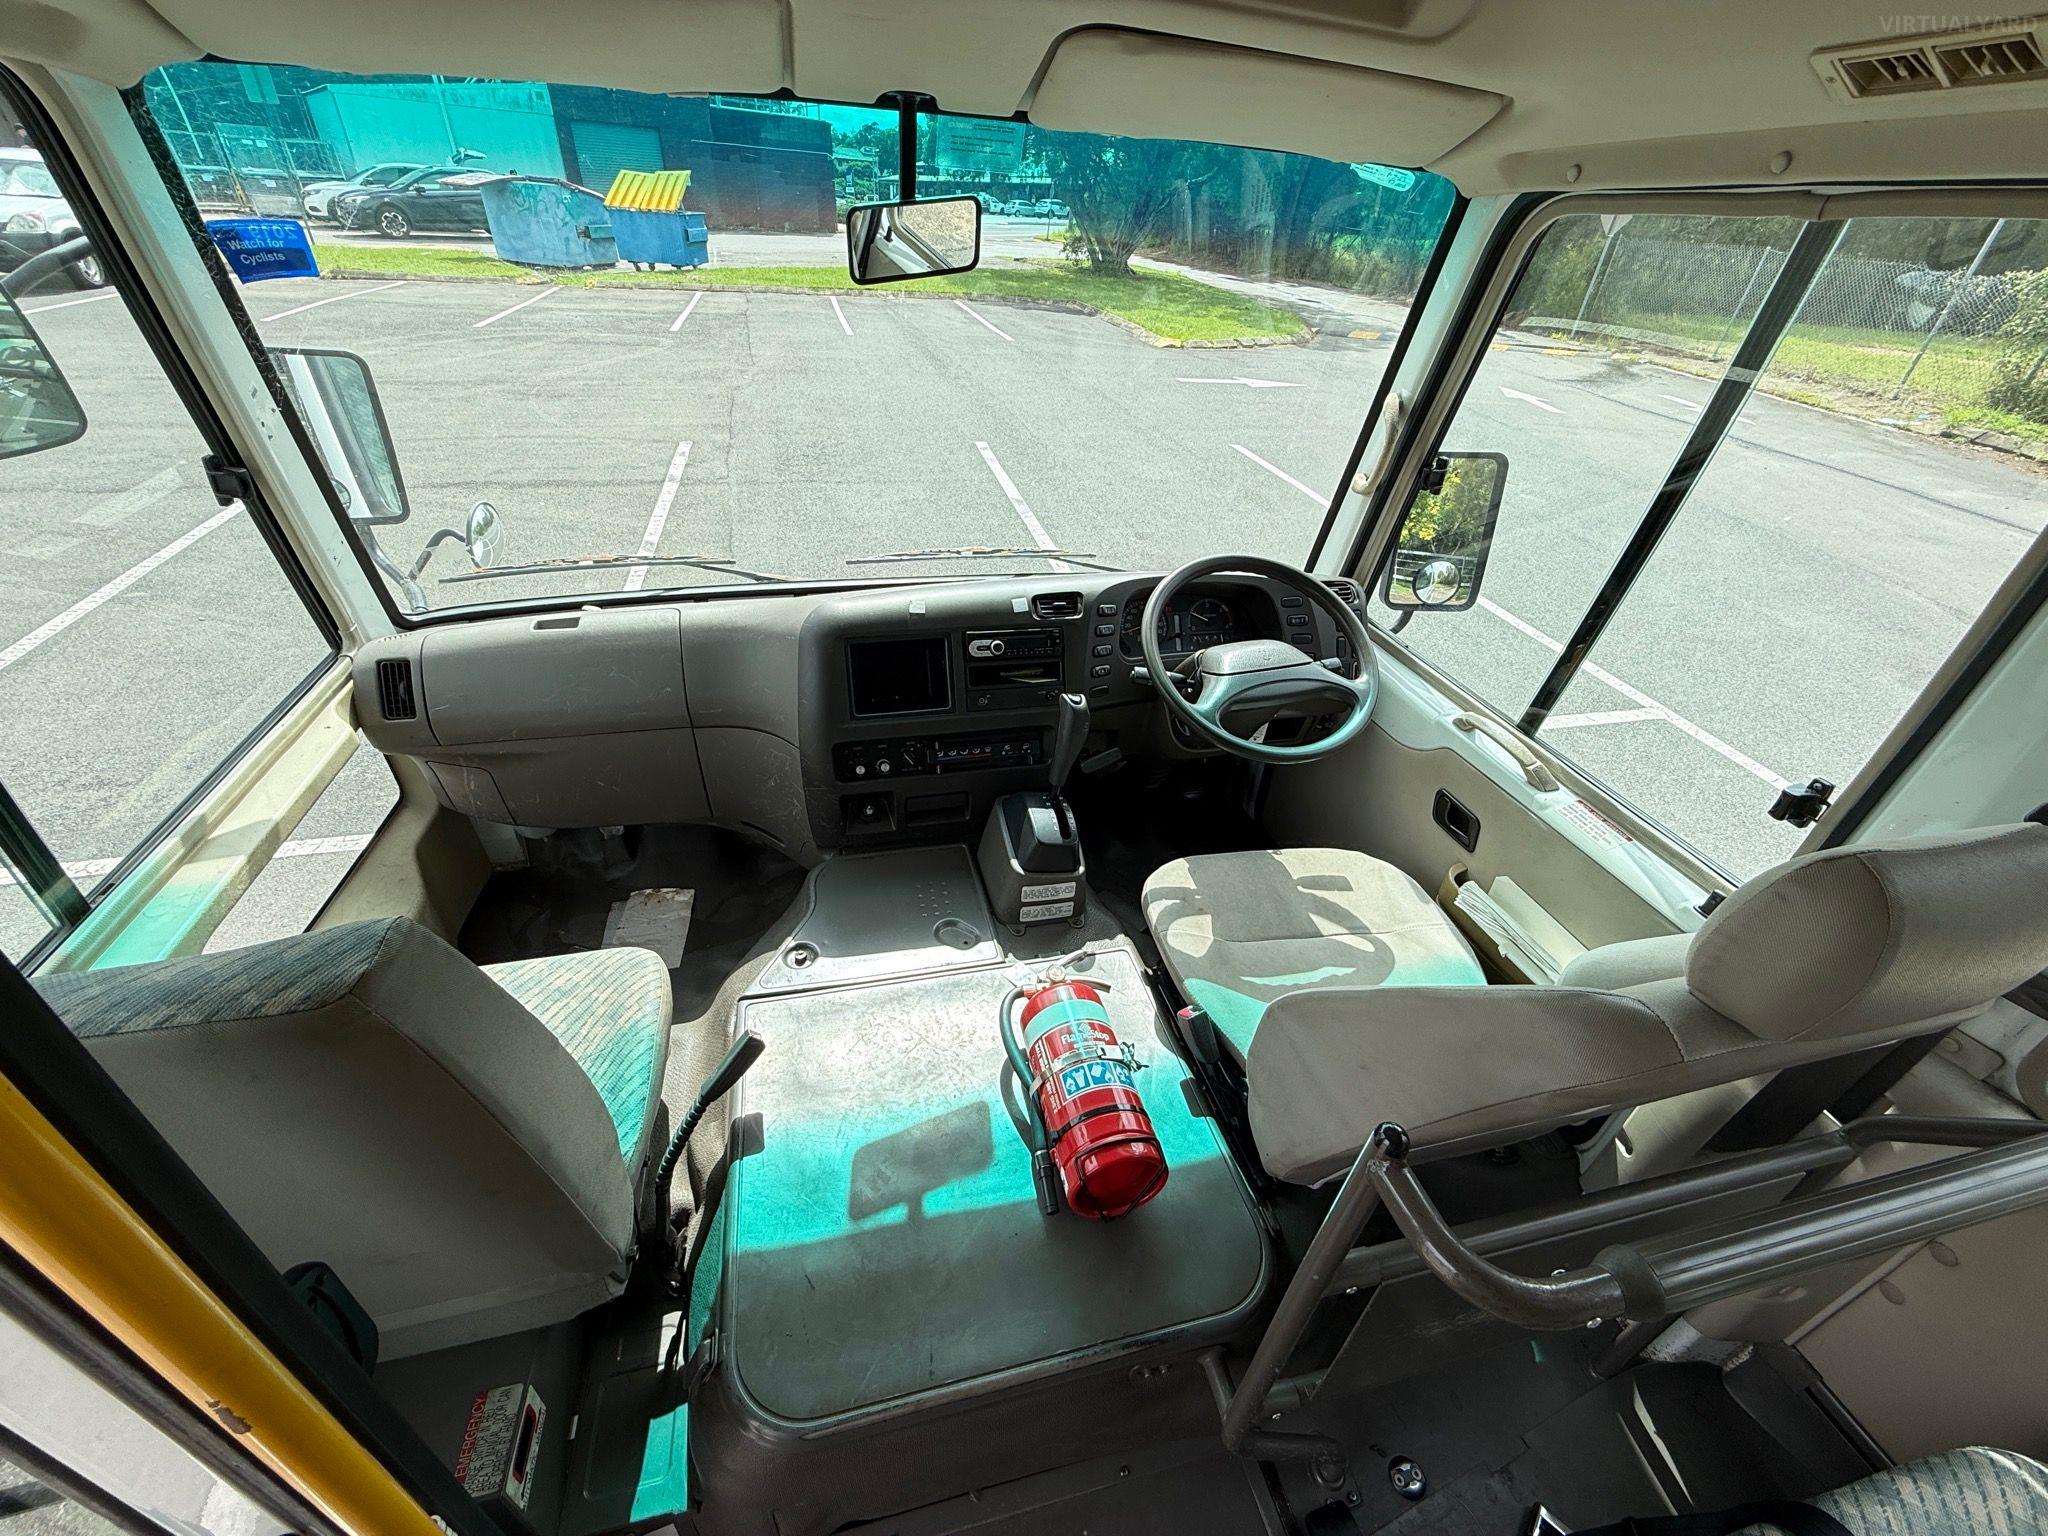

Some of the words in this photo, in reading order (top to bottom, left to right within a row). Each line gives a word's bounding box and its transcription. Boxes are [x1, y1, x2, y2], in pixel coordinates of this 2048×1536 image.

[227, 239, 266, 250] Watch
[267, 239, 285, 248] for
[240, 252, 286, 266] Cyclists
[497, 1388, 512, 1403] CAN
[454, 1398, 486, 1477] EMERGENCY
